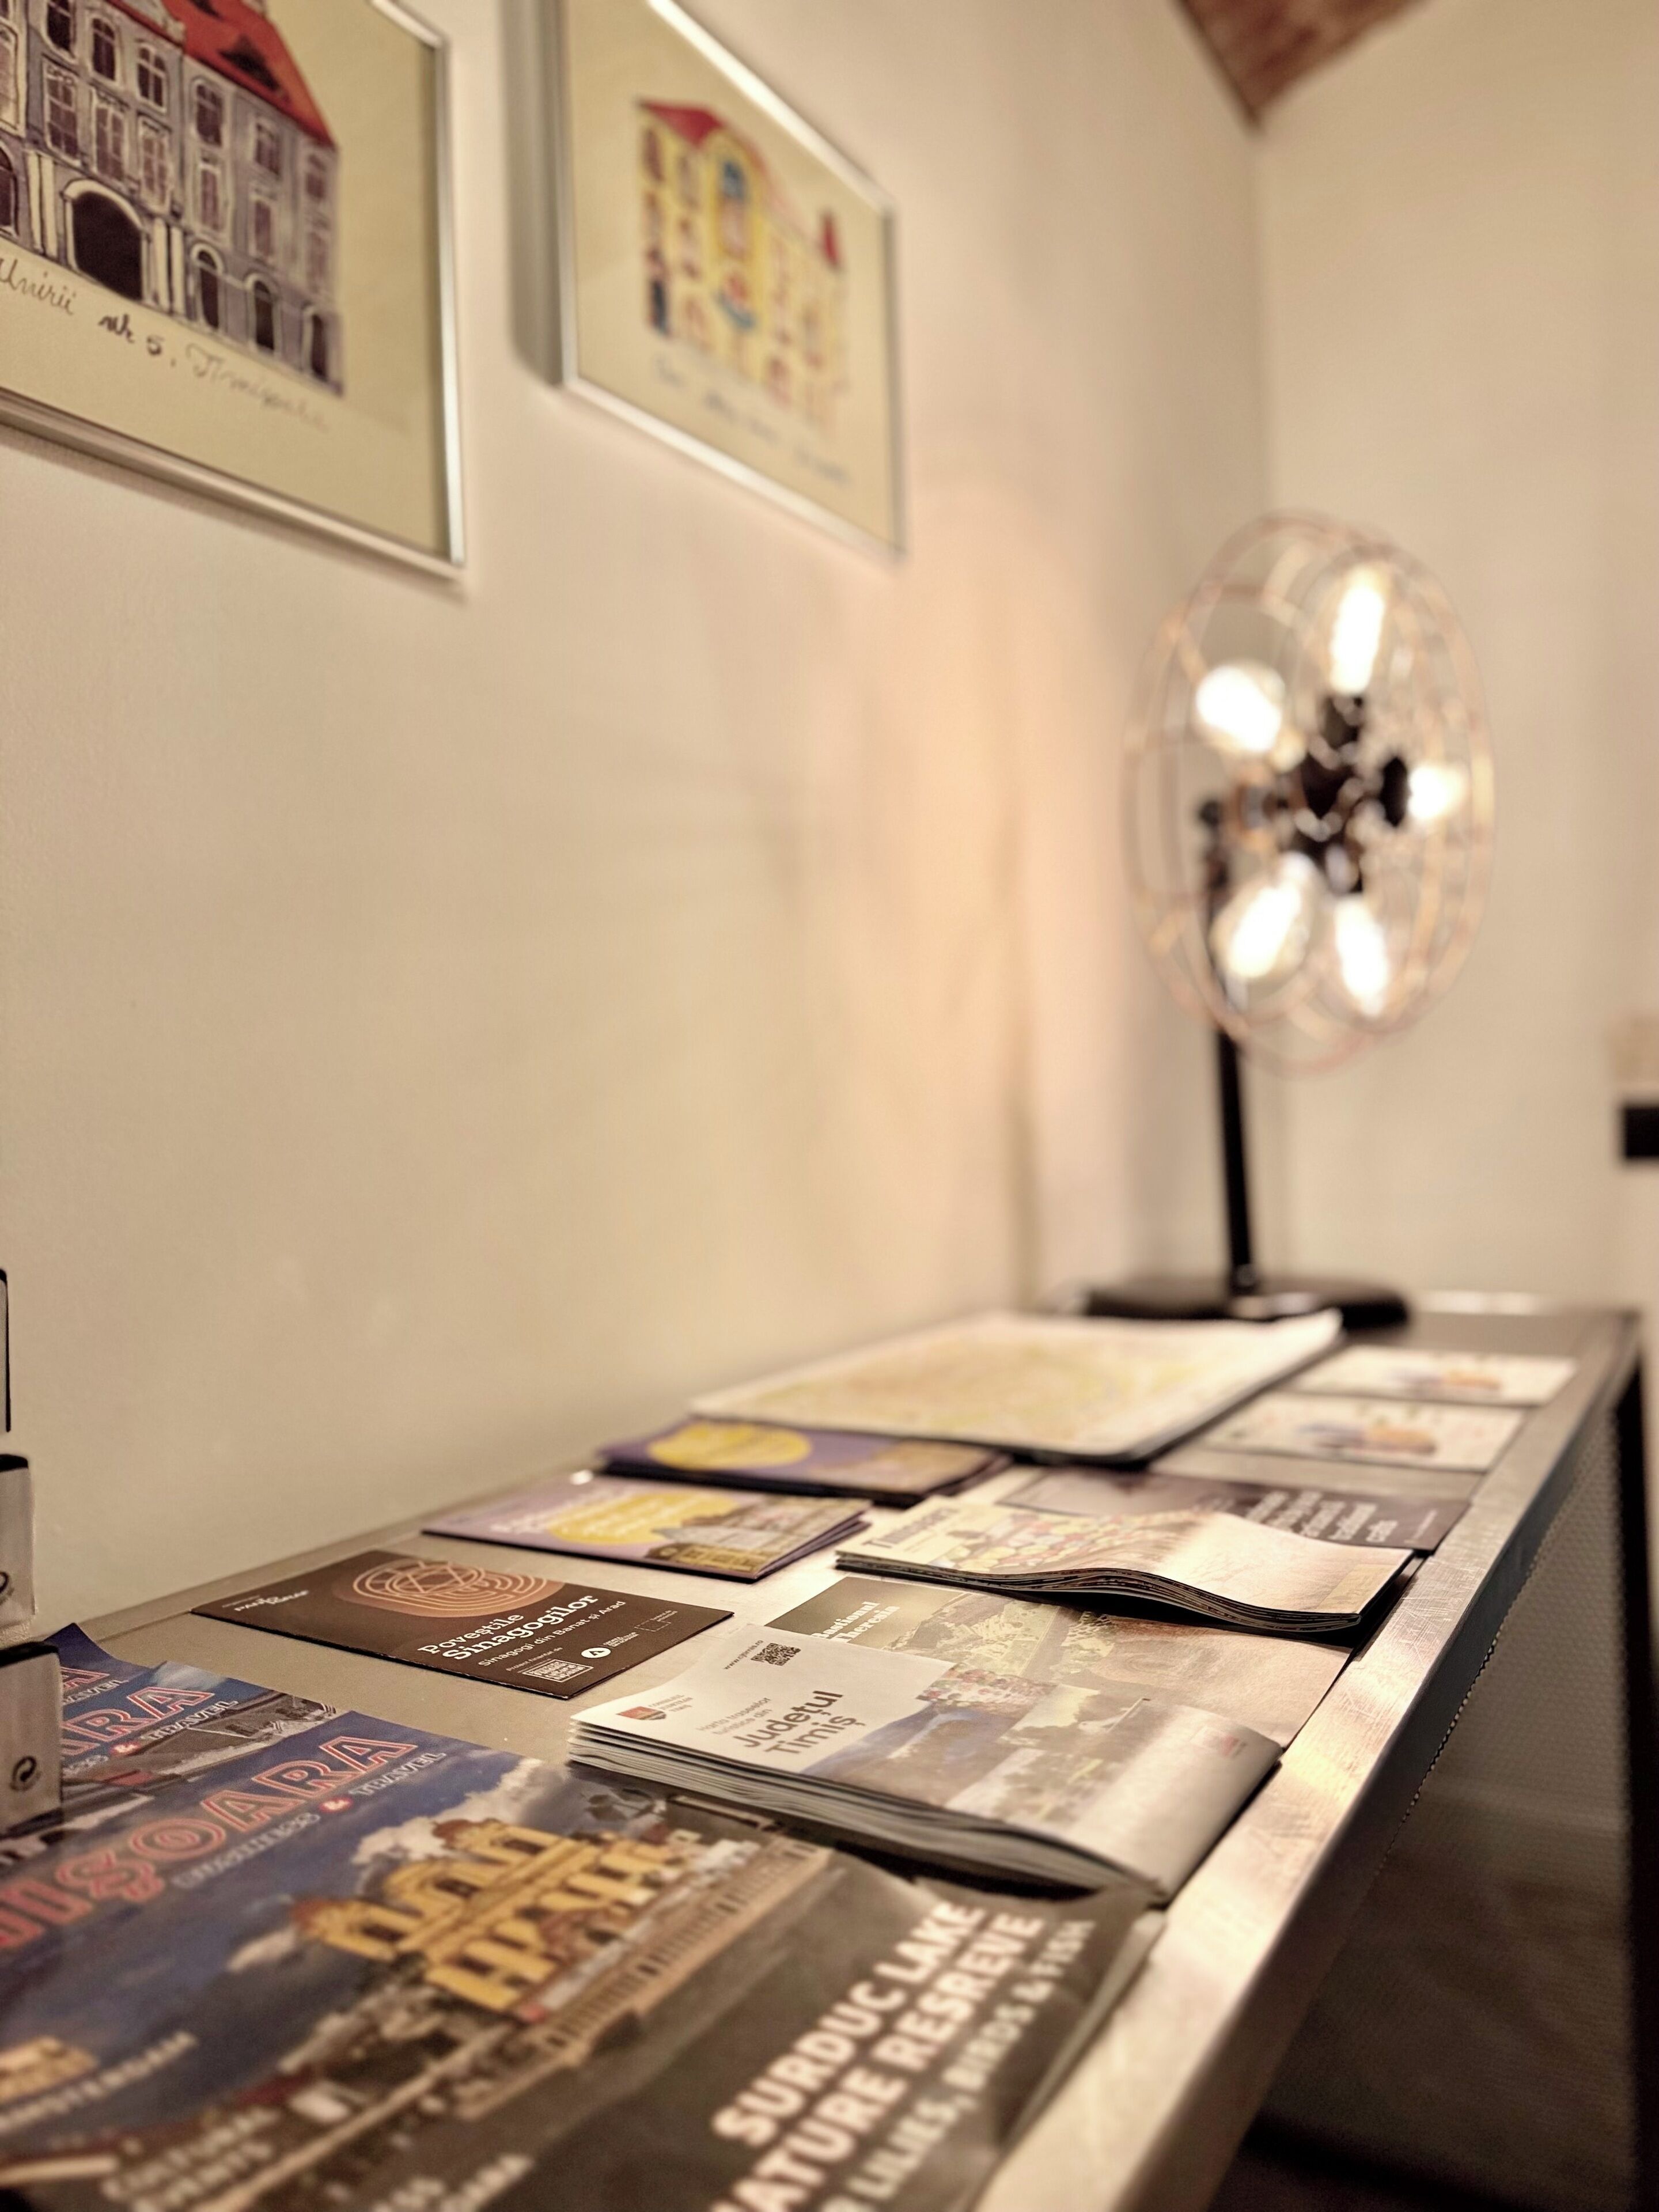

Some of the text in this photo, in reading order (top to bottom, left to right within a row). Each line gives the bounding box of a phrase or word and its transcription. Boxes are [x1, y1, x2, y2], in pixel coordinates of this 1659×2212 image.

[442, 1595, 599, 1660] Sinagogilor
[478, 1643, 535, 1666] Sinagogi
[534, 1634, 555, 1645] din
[552, 1618, 589, 1635] Banat
[599, 1601, 626, 1616] Arad
[141, 1701, 239, 1740] TRAVEL
[733, 1690, 843, 1747] Județul
[764, 1715, 865, 1753] Timiș
[349, 1753, 447, 1796] TRAVEL
[712, 1902, 986, 2146] SURDUC LAKE
[709, 2067, 909, 2212] ATURE
